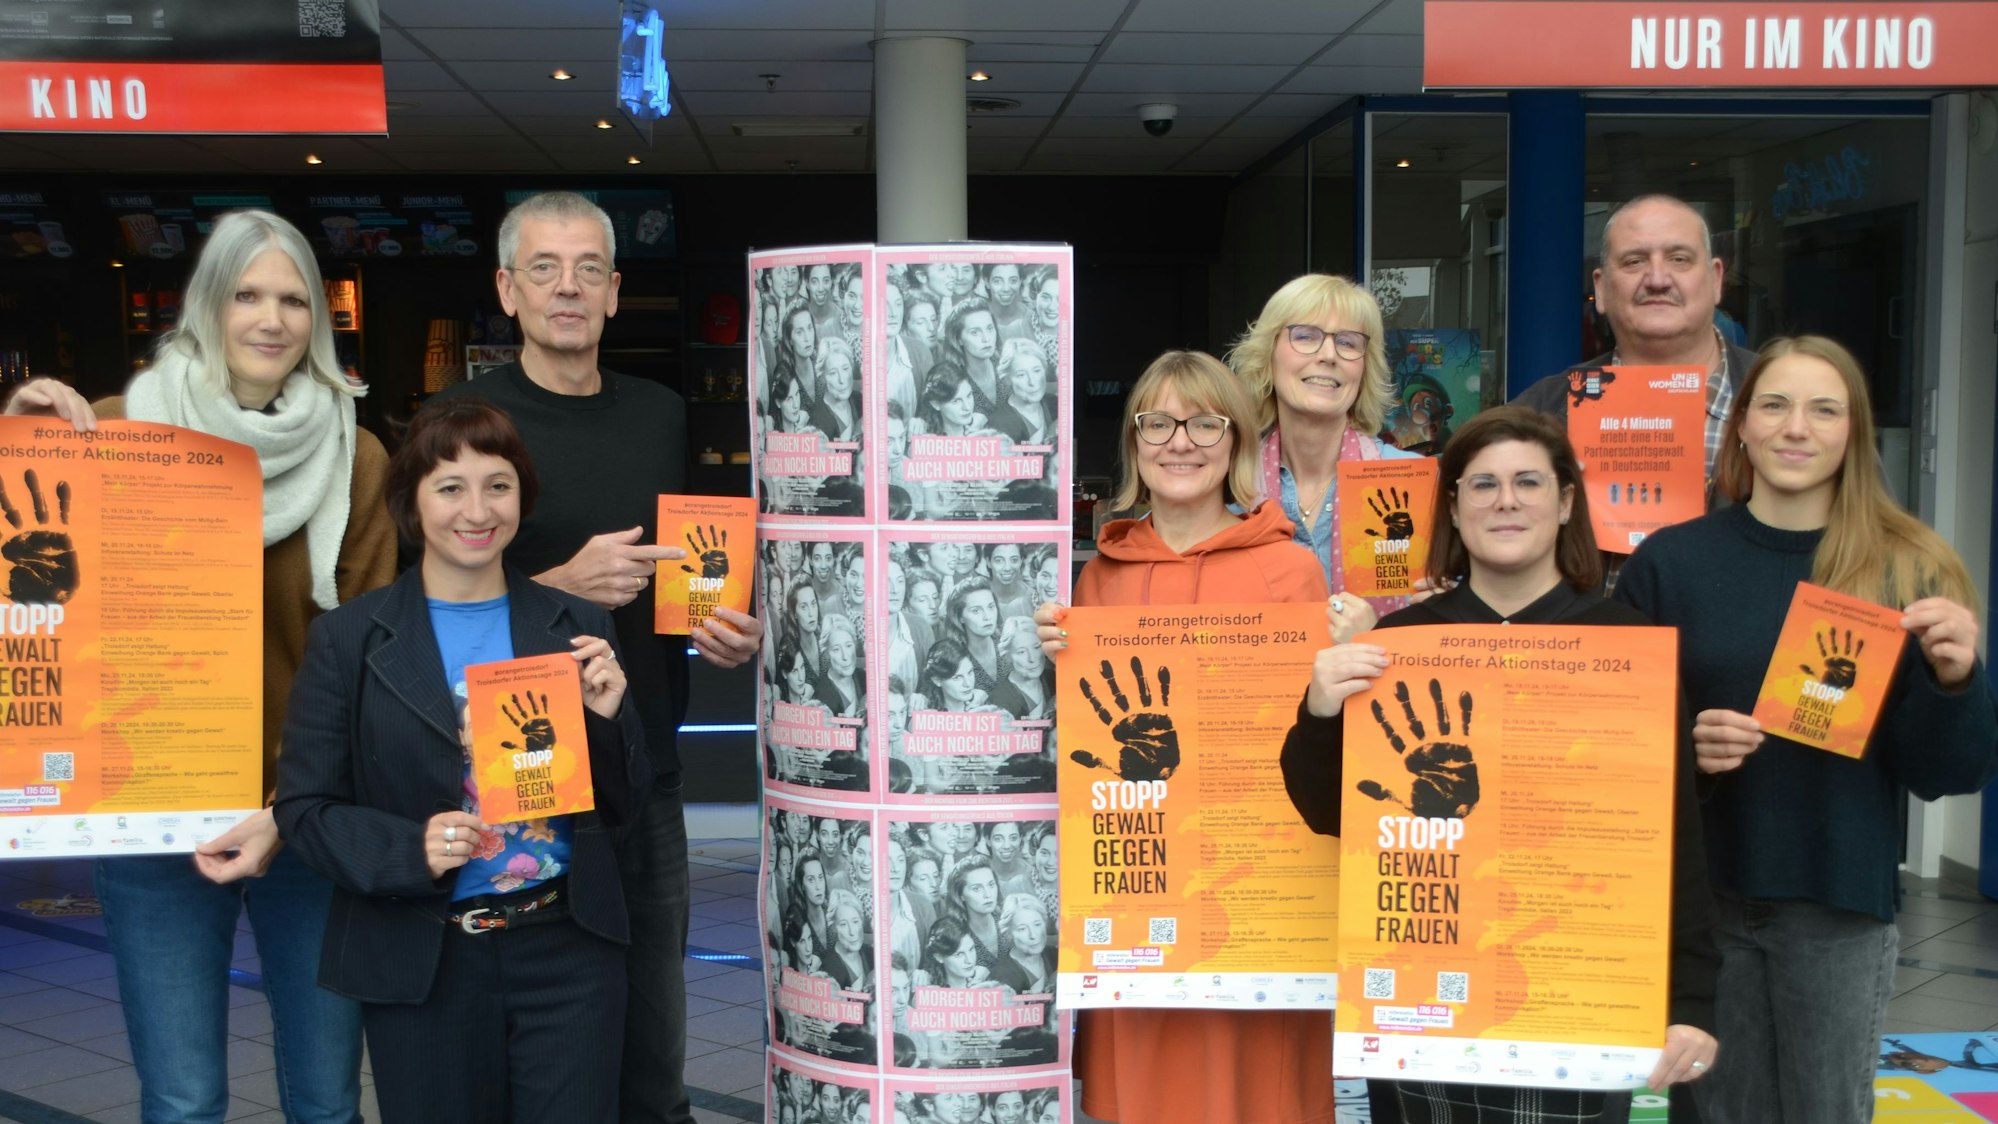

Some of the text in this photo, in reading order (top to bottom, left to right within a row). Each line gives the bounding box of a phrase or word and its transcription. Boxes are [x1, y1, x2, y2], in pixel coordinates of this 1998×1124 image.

[1631, 18, 1934, 70] NUR IM KINO
[31, 78, 147, 120] KINO
[1648, 380, 1686, 389] WOMEN
[1671, 373, 1686, 381] UN
[1600, 417, 1672, 430] Alle 4 Minuten
[34, 426, 176, 444] #orangetroisdorf
[767, 435, 817, 453] MORGEN IST
[1600, 431, 1675, 443] erlebt eine Frau
[0, 444, 225, 466] oisdorfer Aktionstage 2024
[914, 438, 998, 457] MORGEN IST
[1584, 445, 1684, 458] Partnerschaftsgewalt
[765, 455, 850, 473] AUCH NOCH EIN TAG
[907, 459, 1040, 479] AUCH NOCH EIN TAG
[1600, 460, 1673, 472] in Deutschland.
[1373, 539, 1410, 554] STOPP
[1375, 553, 1408, 565] GEWALT
[1375, 565, 1409, 578] GEGEN
[689, 577, 724, 591] STOPP
[1376, 577, 1410, 590] FRAUEN
[689, 592, 722, 603] GEWALT
[0, 604, 65, 635] TOPP
[1138, 613, 1263, 629] #orangetroisdorf
[1094, 631, 1308, 647] Troisdorfer Aktionstage 2024
[1439, 635, 1582, 651] #orangetroisdorf
[0, 638, 62, 662] WALT
[1390, 652, 1632, 673] Troisdorfer Aktionstage 2024
[0, 667, 62, 697] EGEN
[1802, 680, 1845, 702] STOPP
[0, 701, 62, 726] AUEN
[775, 705, 822, 726] MORGEN IST
[1798, 696, 1836, 716] GEWALT
[915, 714, 997, 732] MORGEN IST
[1792, 709, 1832, 731] GEGEN
[772, 725, 854, 748] AUCH NOCH EIN TAG
[1788, 721, 1827, 742] FRAUEN
[907, 733, 1040, 753] AUCH NOCH EIN TAG
[512, 749, 553, 770] STOPP
[515, 767, 552, 783] GEWALT
[516, 780, 555, 798] GEGEN
[1091, 780, 1168, 810] STOPP
[517, 796, 556, 813] FRAUEN
[1093, 812, 1166, 835] GEWALT
[1378, 816, 1465, 850] STOPP
[1093, 838, 1167, 866] GEGEN
[1378, 851, 1460, 879] GEWALT
[1094, 870, 1168, 895] FRAUEN
[1377, 881, 1460, 914] GEGEN
[1376, 916, 1459, 945] FRAUEN
[782, 969, 829, 998] MORGEN IST
[780, 990, 861, 1022] AUCH NOCH EIN TAG
[918, 990, 1000, 1008] MORGEN IST
[911, 1007, 1041, 1028] AUCH NOCH EIN TAG
[1419, 1005, 1447, 1015] 116 016
